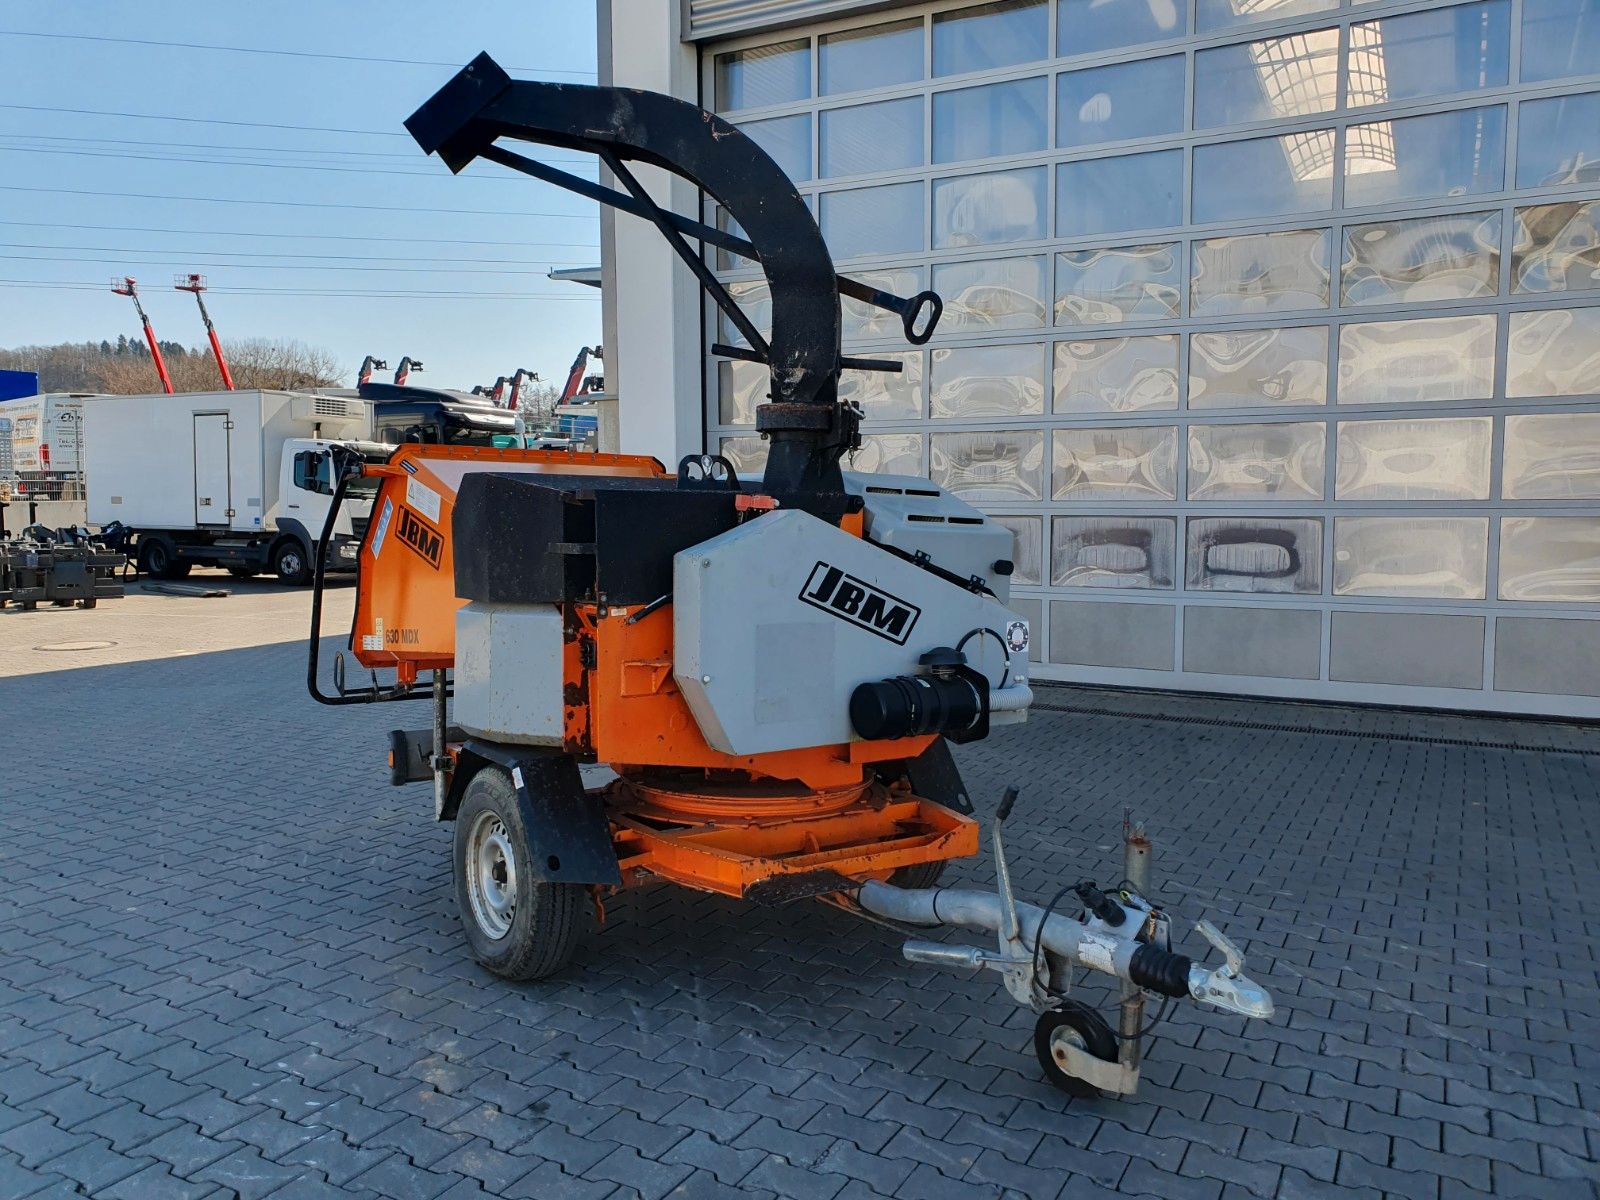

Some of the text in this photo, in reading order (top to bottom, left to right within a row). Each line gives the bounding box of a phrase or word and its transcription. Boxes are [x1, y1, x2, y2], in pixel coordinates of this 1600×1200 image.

[398, 507, 440, 562] JBM
[807, 566, 912, 637] JBM
[386, 629, 399, 644] 630
[401, 628, 420, 644] MDX
